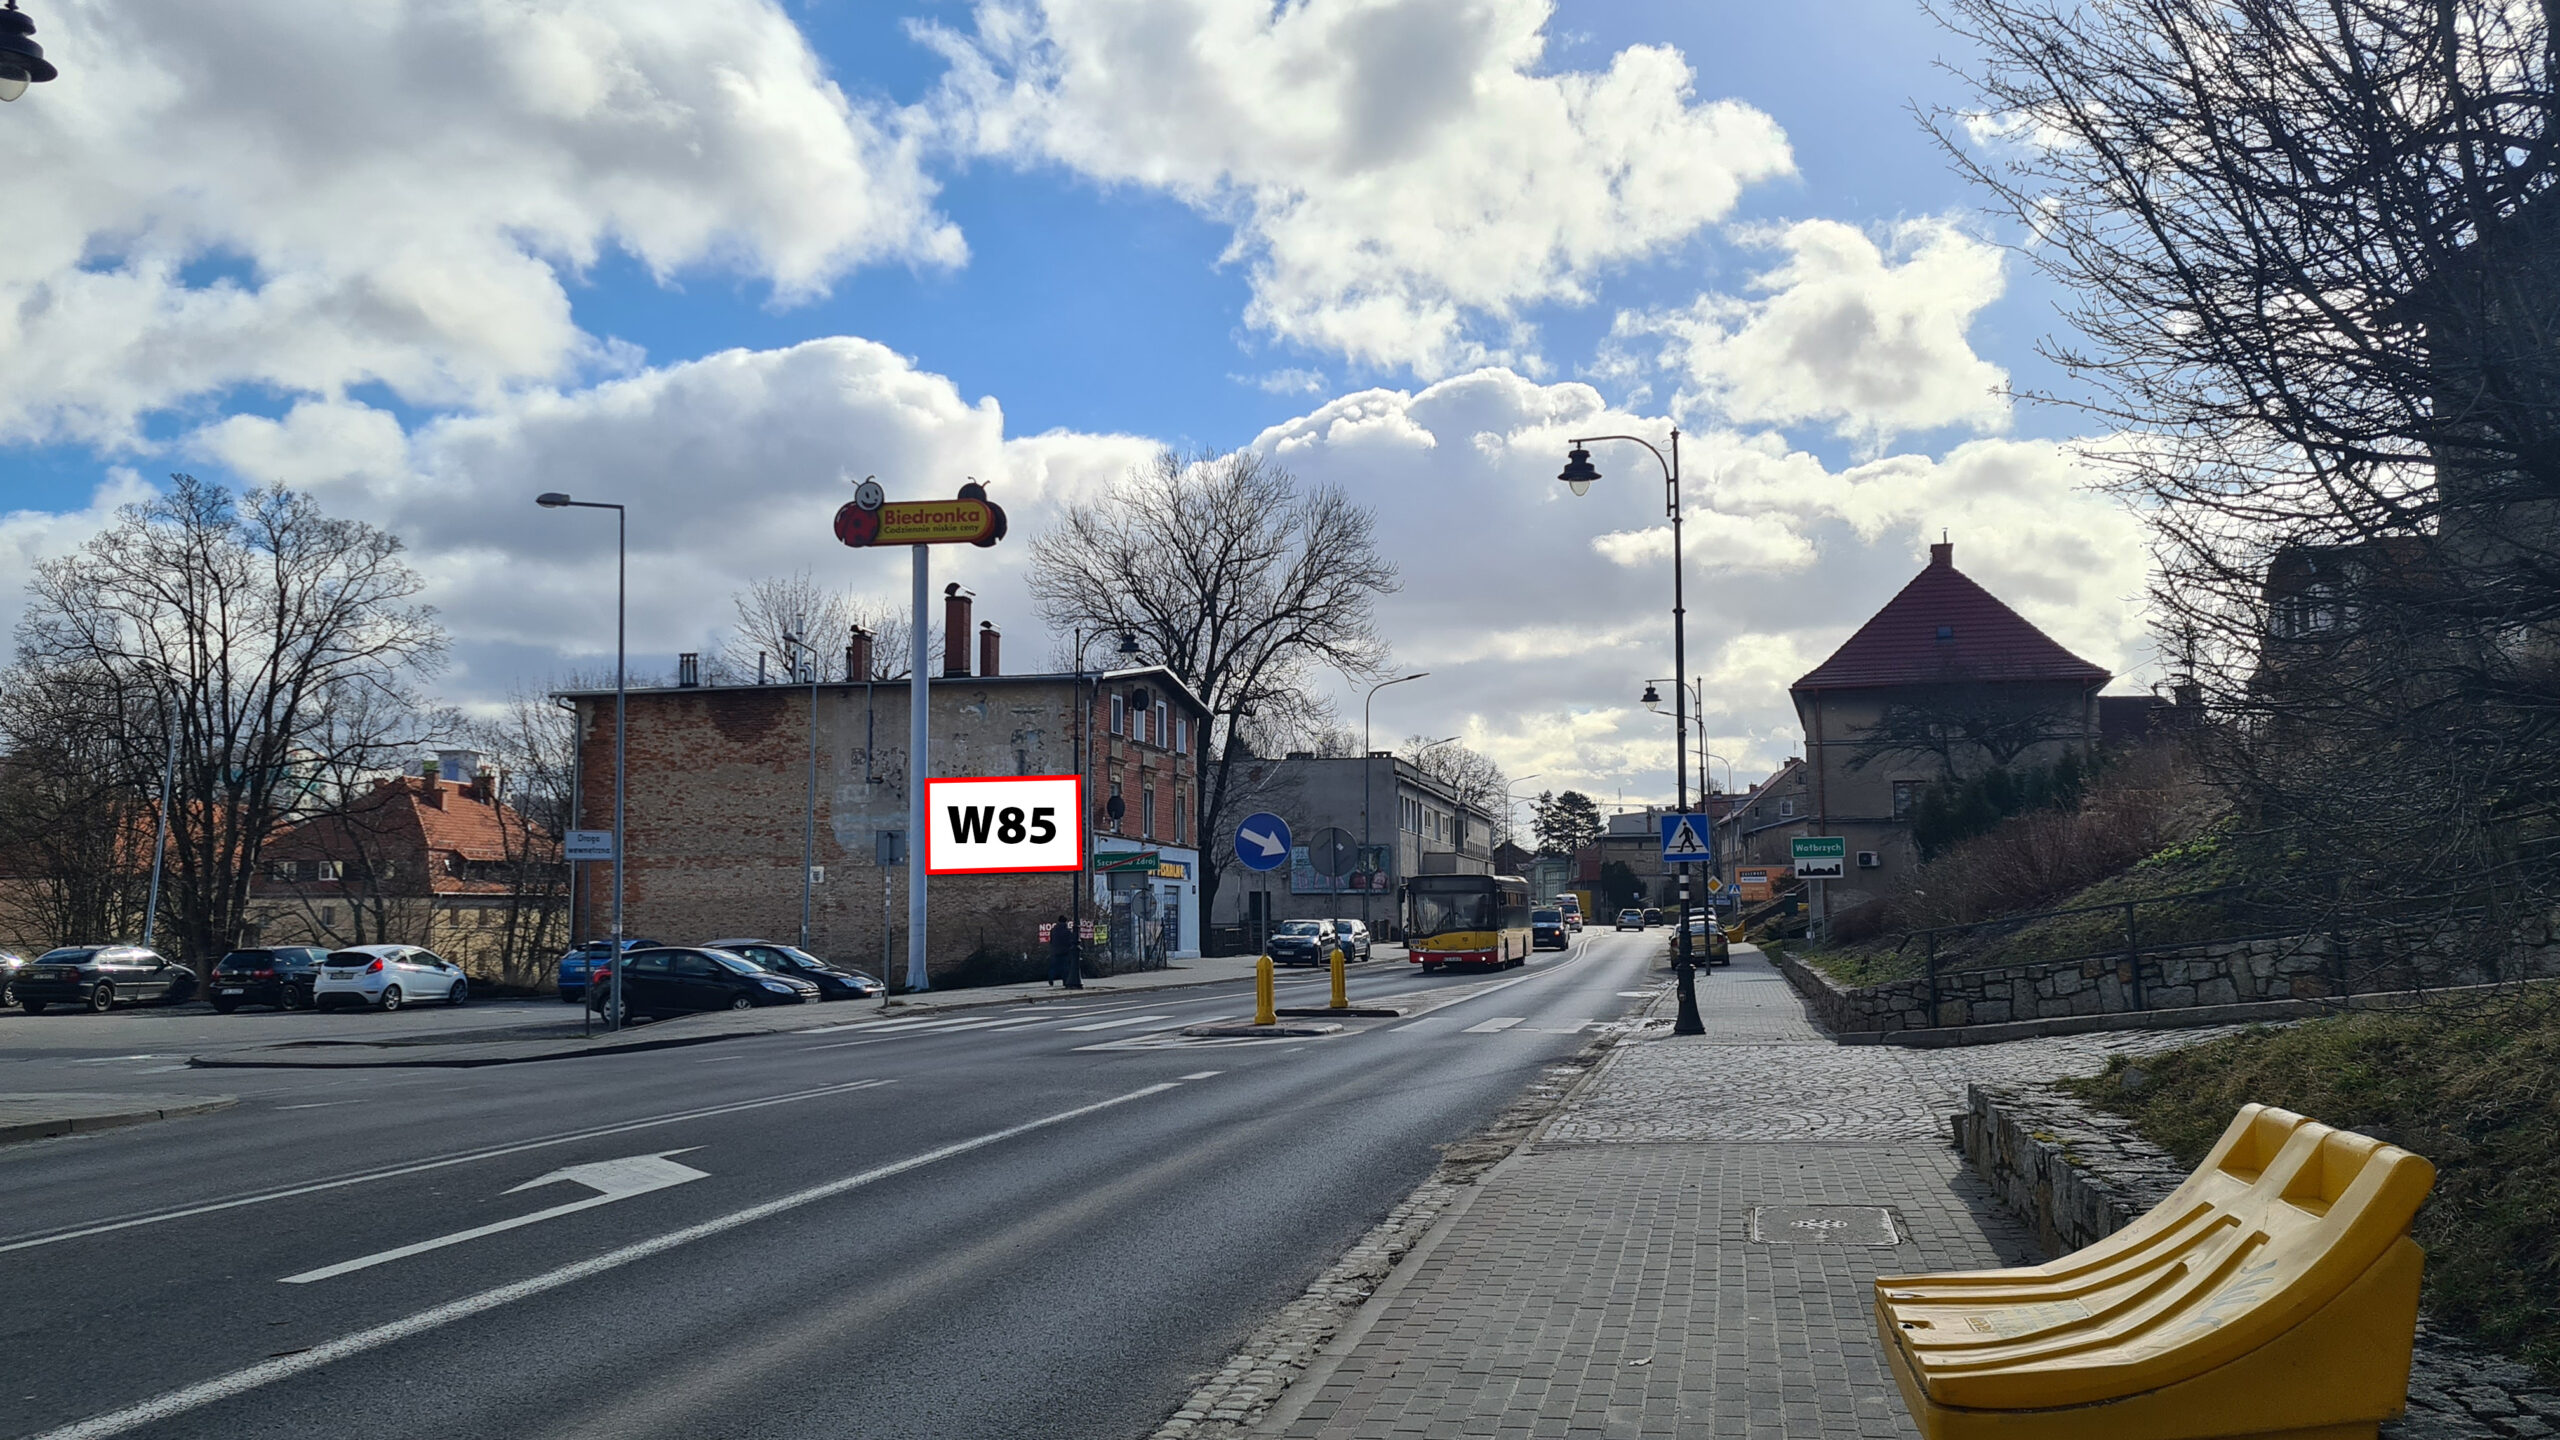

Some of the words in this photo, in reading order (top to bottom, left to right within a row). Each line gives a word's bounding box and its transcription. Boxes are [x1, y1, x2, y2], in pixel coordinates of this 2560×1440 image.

[885, 507, 980, 525] Biedronka
[884, 525, 930, 534] Codziennie
[933, 524, 957, 532] niskie
[960, 524, 979, 532] ceny
[1795, 843, 1841, 853] Wałbrzych
[1097, 858, 1133, 867] Szczo
